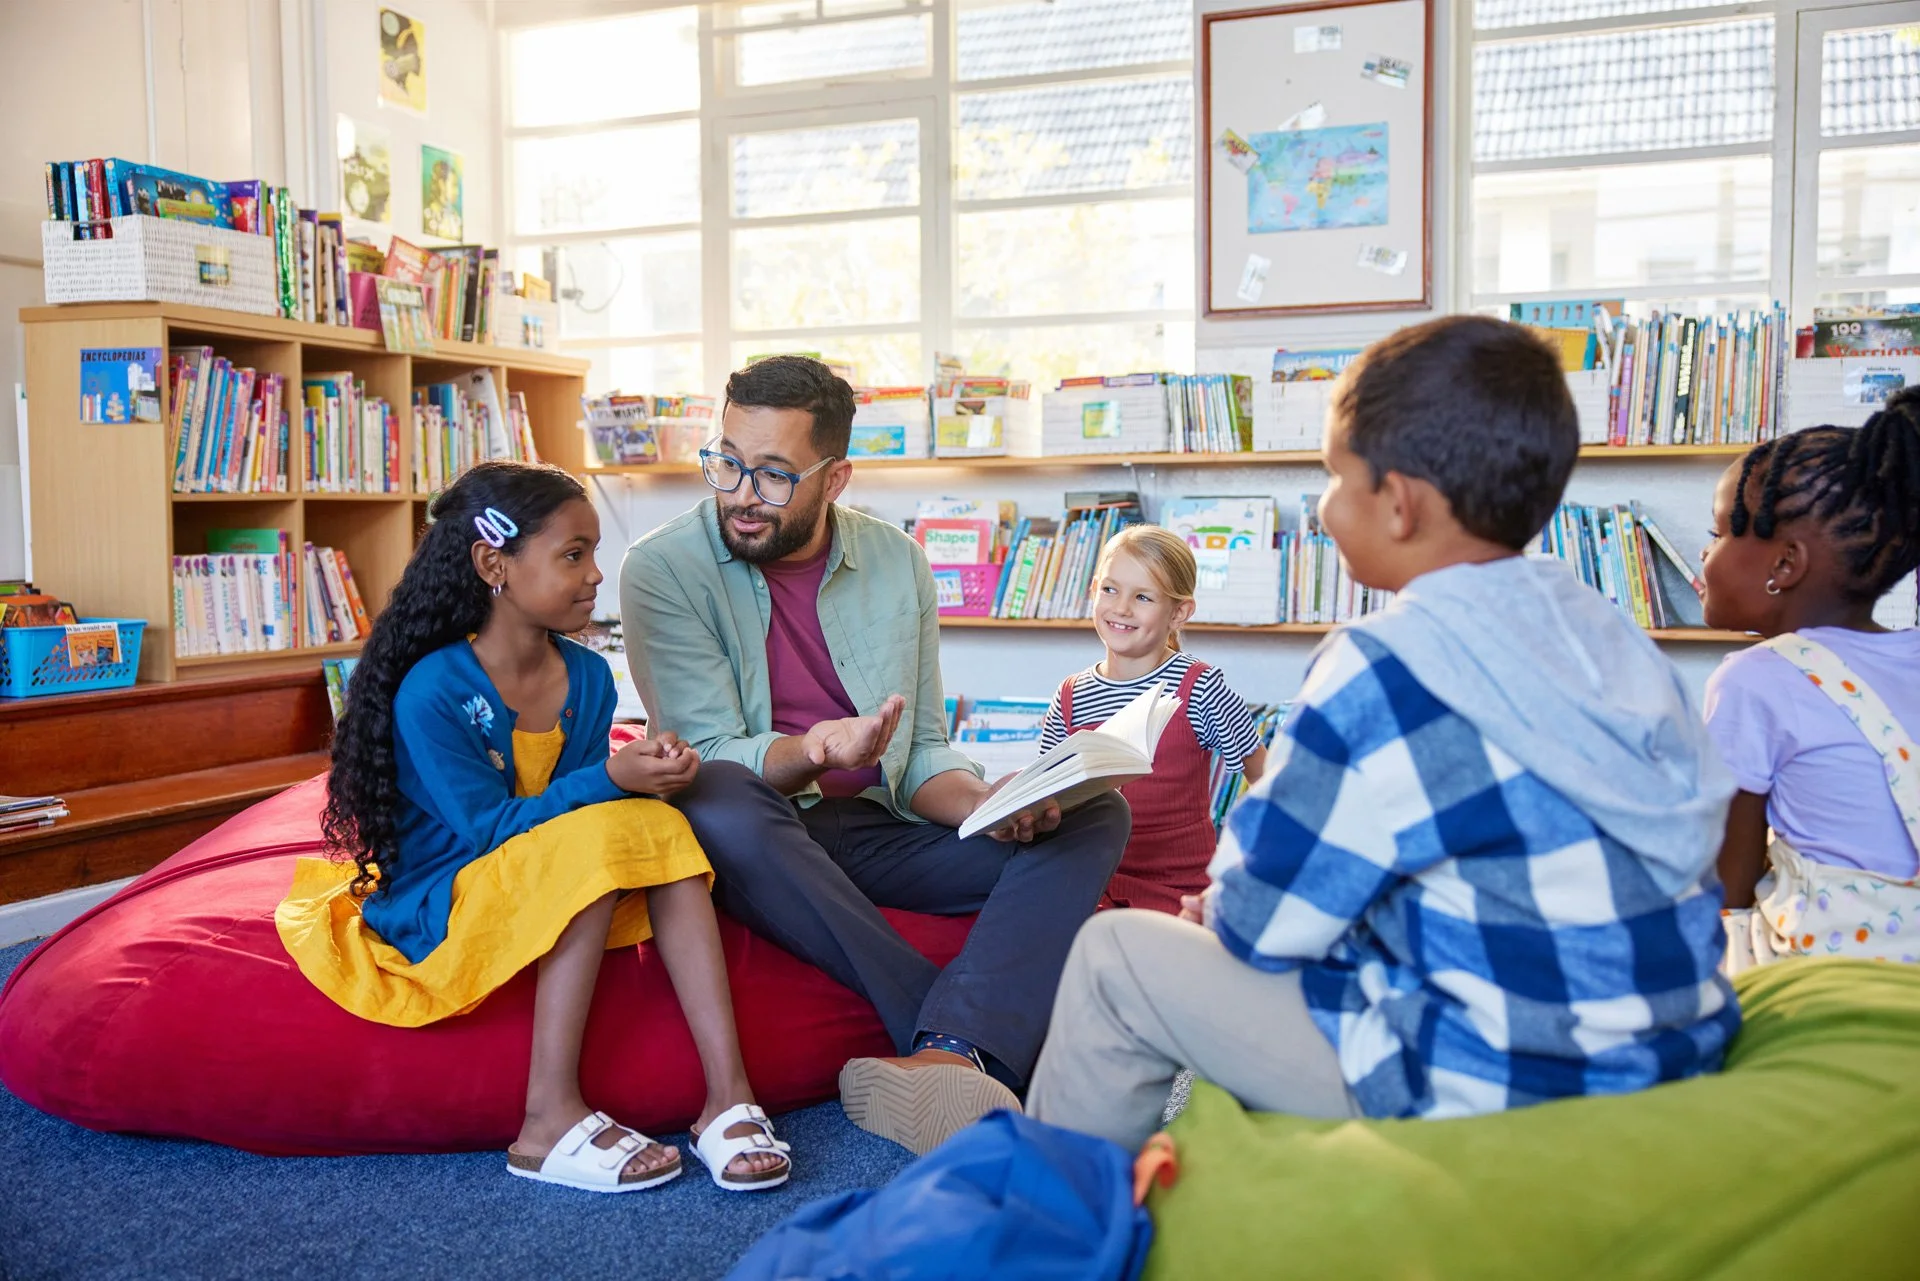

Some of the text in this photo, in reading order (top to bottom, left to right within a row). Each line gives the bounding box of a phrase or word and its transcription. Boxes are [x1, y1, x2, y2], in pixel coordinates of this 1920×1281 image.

[1830, 322, 1862, 337] 100
[81, 351, 146, 362] ENCYCLOPEDIAS
[925, 530, 977, 544] Shapes
[203, 581, 216, 638] HISTORY
[221, 583, 233, 633] ANIMALS
